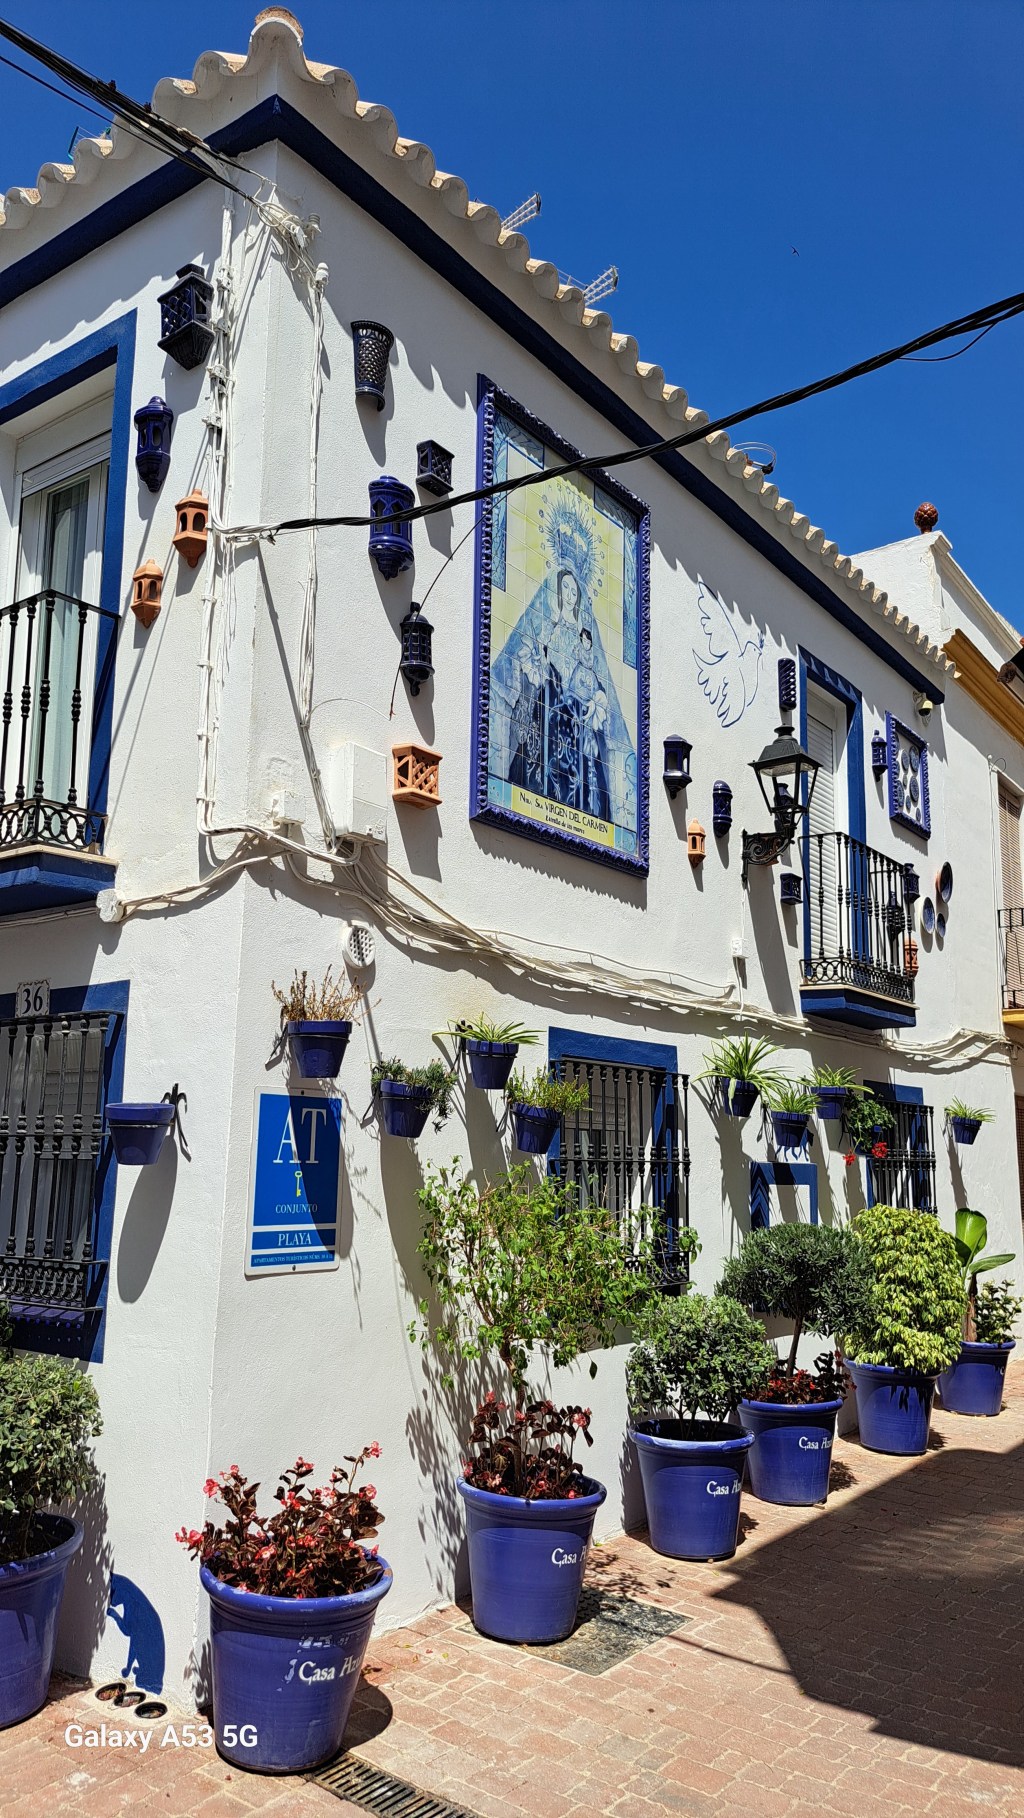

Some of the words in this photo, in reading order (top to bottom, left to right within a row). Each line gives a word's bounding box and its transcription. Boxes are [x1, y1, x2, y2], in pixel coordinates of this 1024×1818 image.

[545, 801, 567, 818] VIRGEN
[569, 811, 581, 824] DEL
[582, 816, 608, 834] CARMEN
[22, 985, 43, 1015] 36
[272, 1106, 327, 1164] AT
[275, 1203, 318, 1214] CONJUNTO
[278, 1232, 312, 1246] PLAYA
[798, 1436, 819, 1451] Casa
[706, 1480, 730, 1498] Casa
[551, 1547, 577, 1568] Casa
[298, 1661, 336, 1685] Casa
